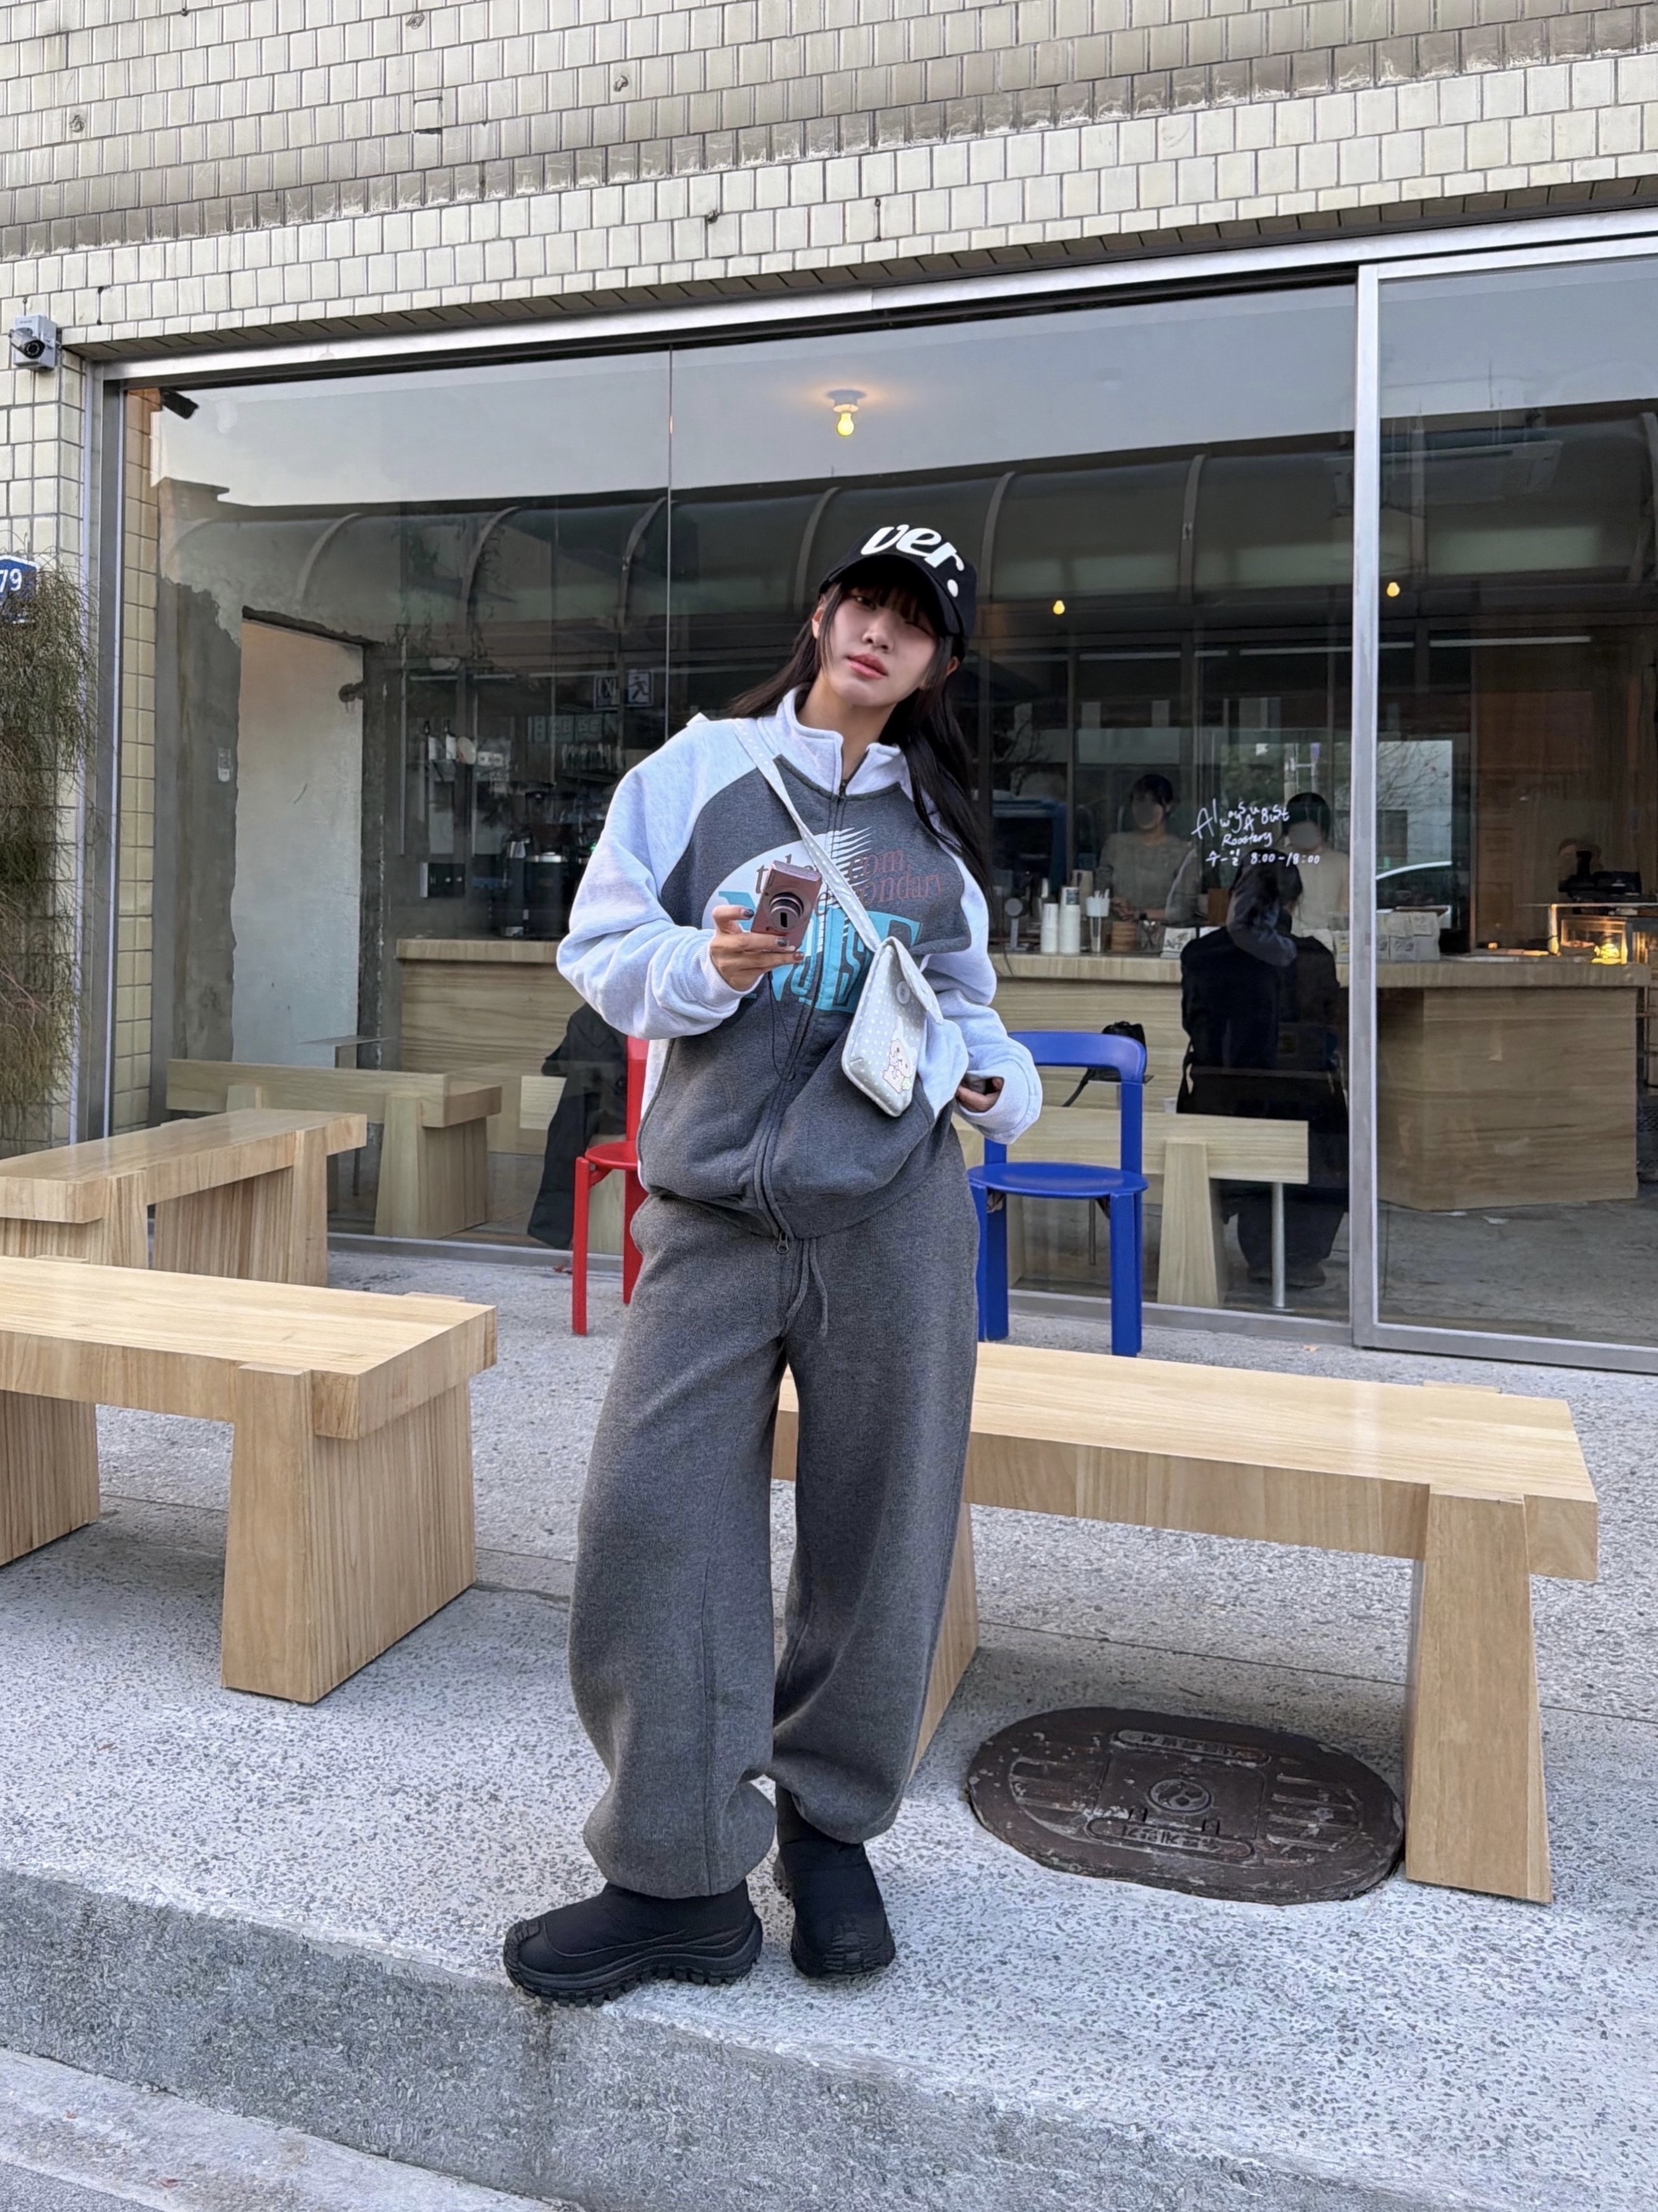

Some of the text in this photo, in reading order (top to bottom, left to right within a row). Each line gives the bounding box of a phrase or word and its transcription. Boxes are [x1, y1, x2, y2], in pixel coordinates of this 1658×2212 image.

[0, 568, 22, 592] 79
[1191, 798, 1290, 840] Always August
